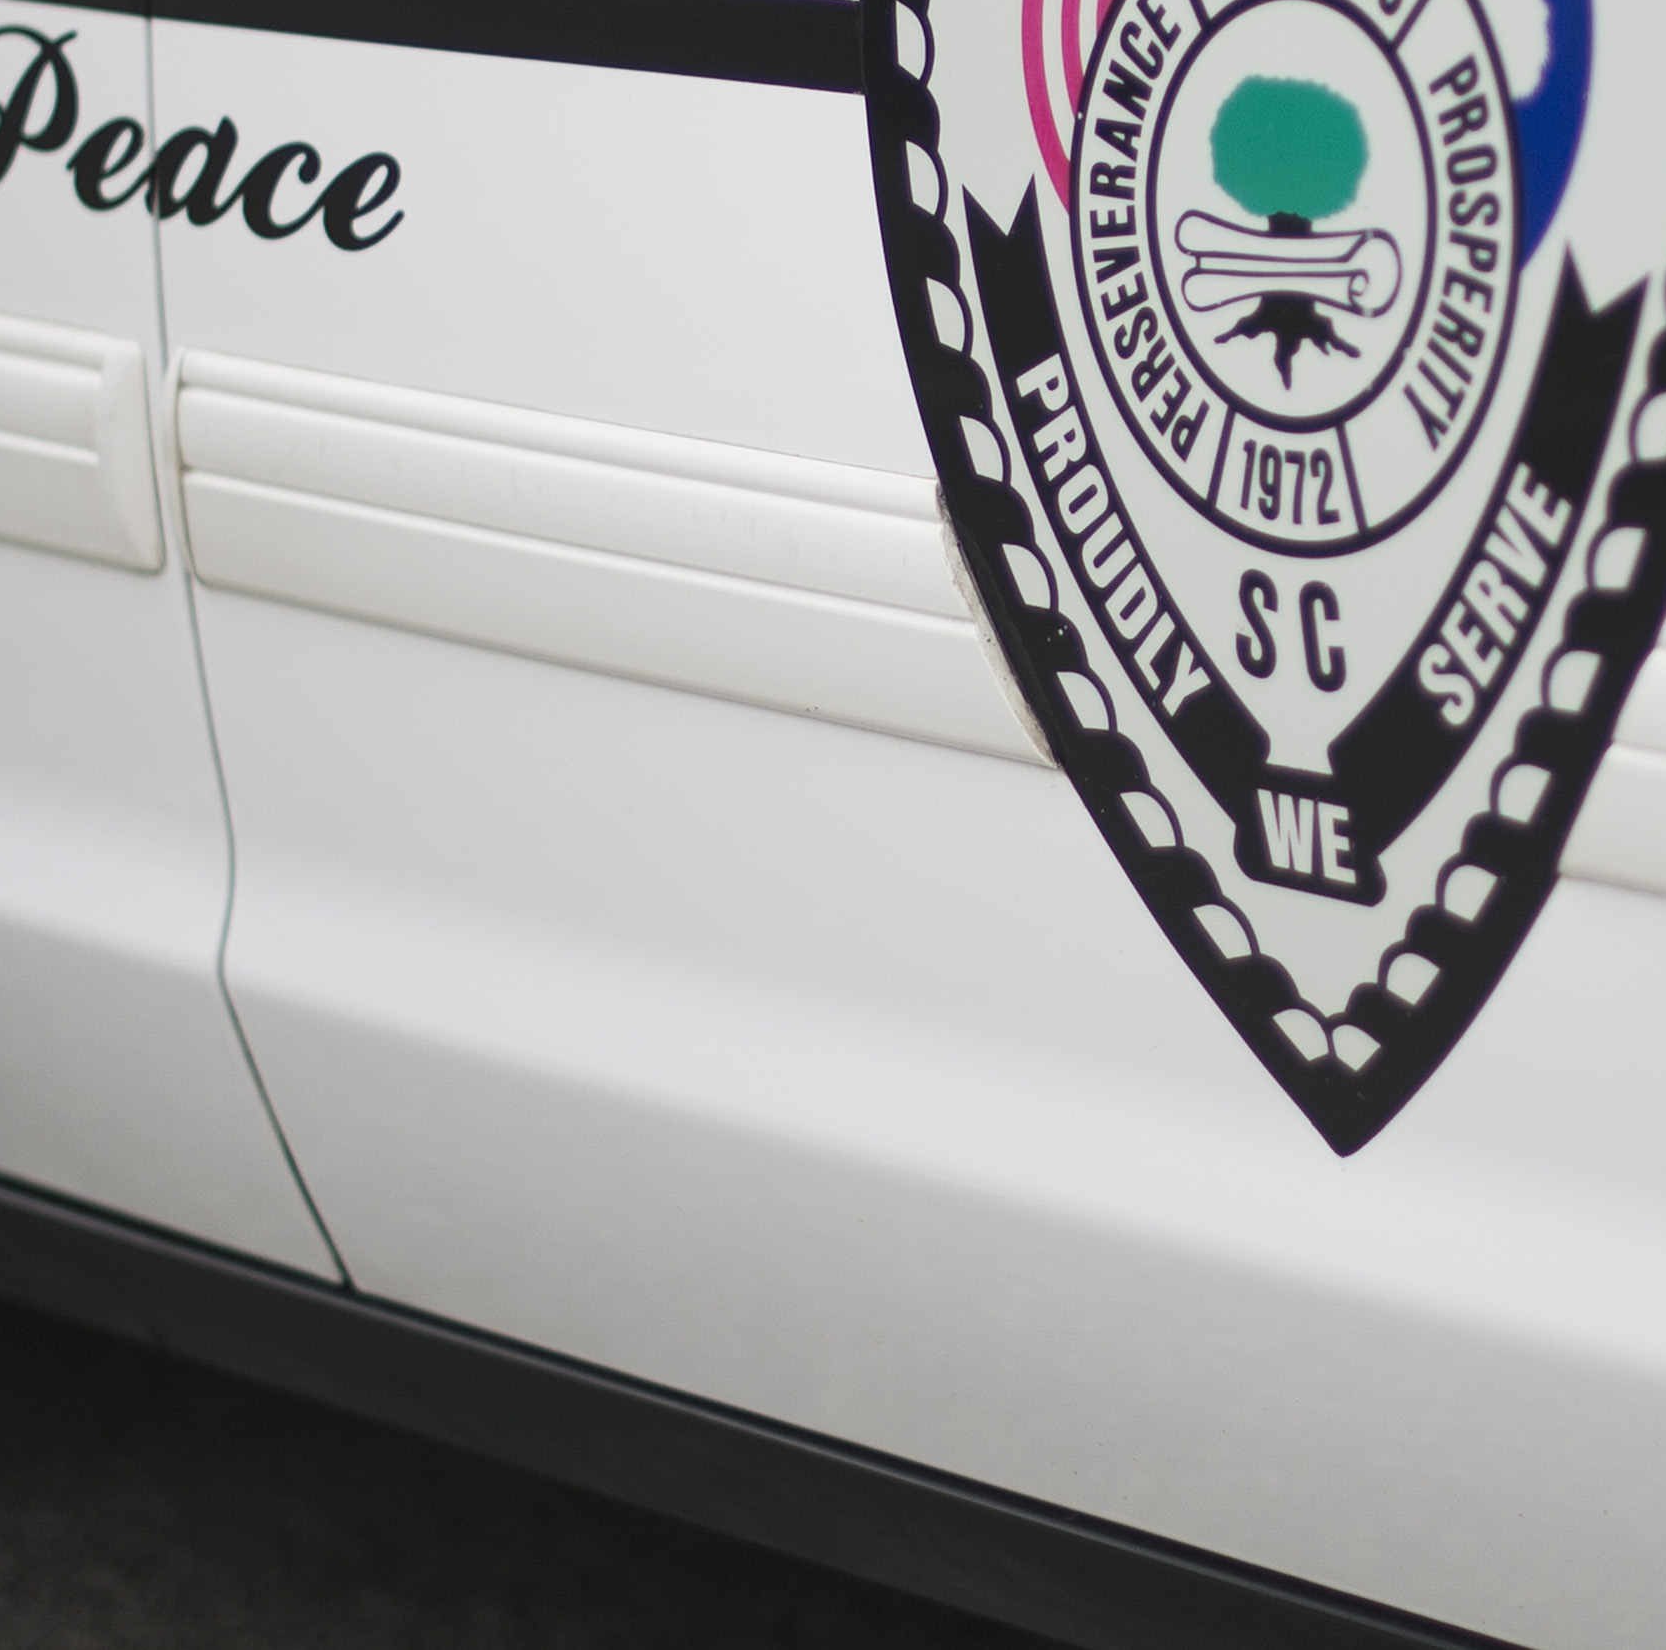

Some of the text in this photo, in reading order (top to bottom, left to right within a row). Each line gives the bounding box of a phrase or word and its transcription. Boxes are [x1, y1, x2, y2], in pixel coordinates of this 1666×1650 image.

[1403, 54, 1501, 451] PROSPERITY
[1015, 352, 1572, 885] PROUDLY WE SERVE
[1239, 438, 1342, 527] 1972
